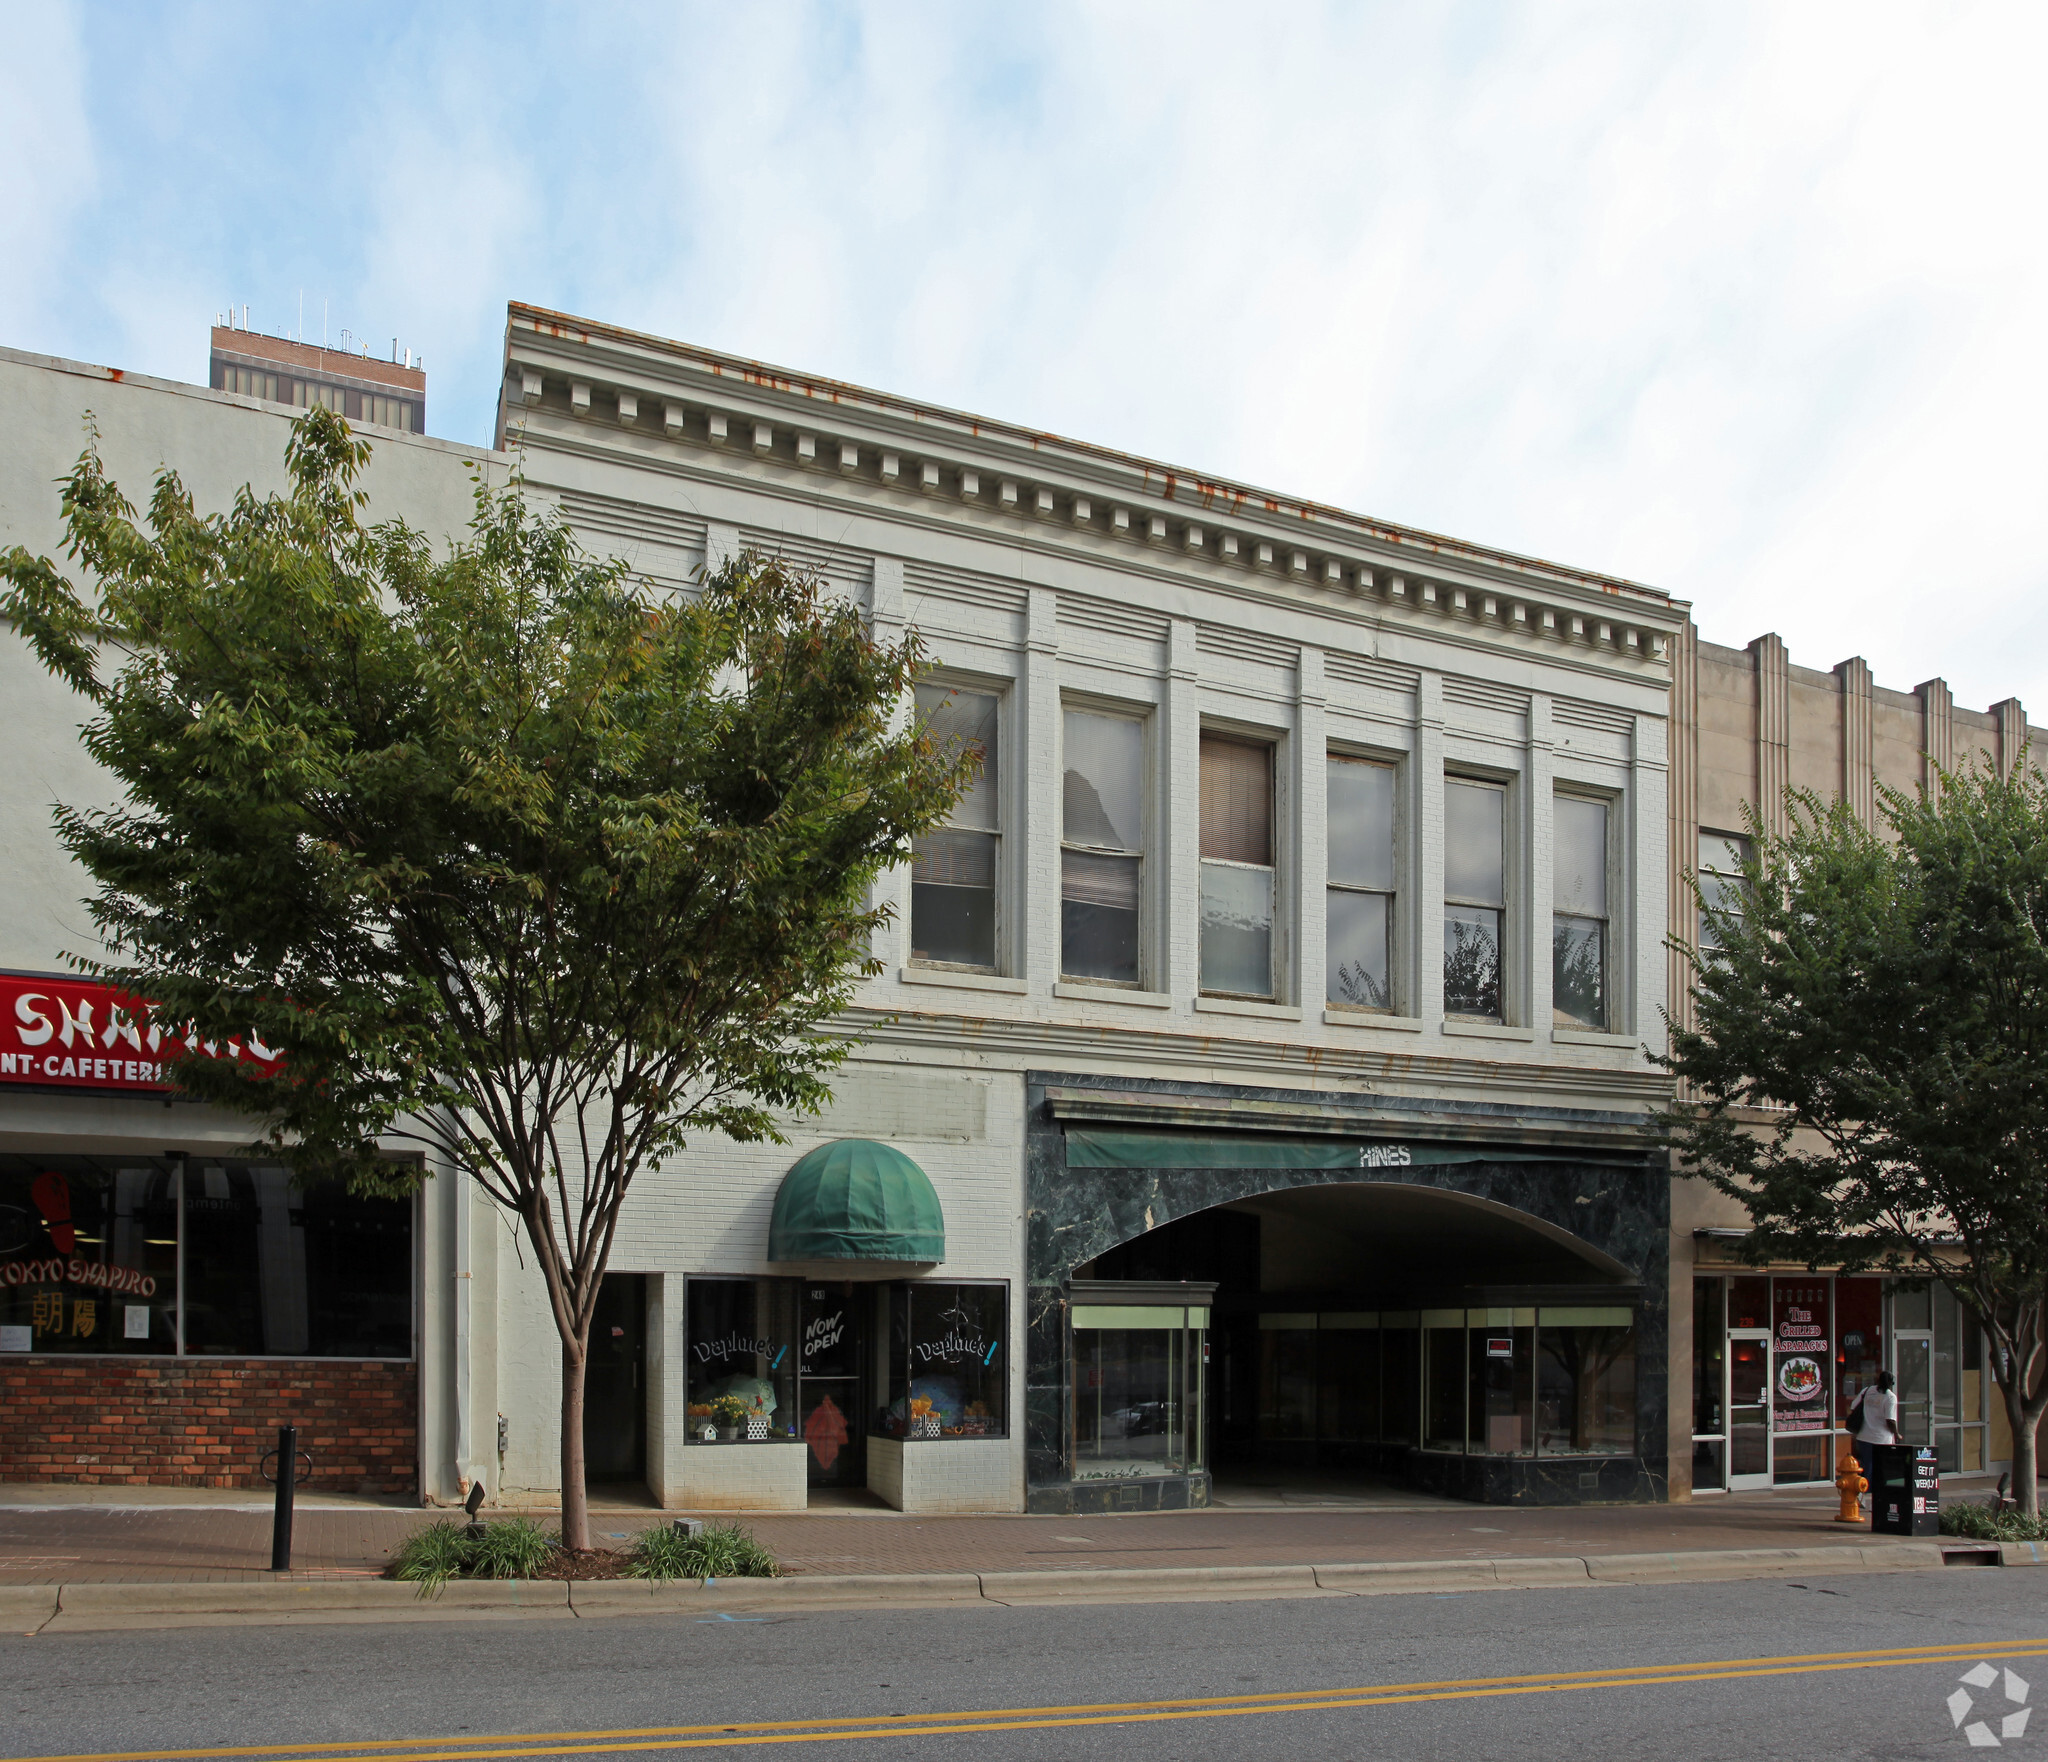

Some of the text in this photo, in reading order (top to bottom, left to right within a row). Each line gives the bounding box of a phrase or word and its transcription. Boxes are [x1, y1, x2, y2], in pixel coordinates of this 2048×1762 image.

[1359, 1145, 1411, 1168] HINES
[66, 1258, 157, 1298] SHAPIRO
[1788, 1306, 1812, 1322] THE
[805, 1310, 843, 1341] NOW
[1779, 1322, 1822, 1337] GRILLED
[804, 1324, 845, 1357] OPEN
[1773, 1337, 1829, 1352] ASPARAGUS
[1844, 1335, 1862, 1346] OPEN
[1918, 1465, 1935, 1476] GET IT
